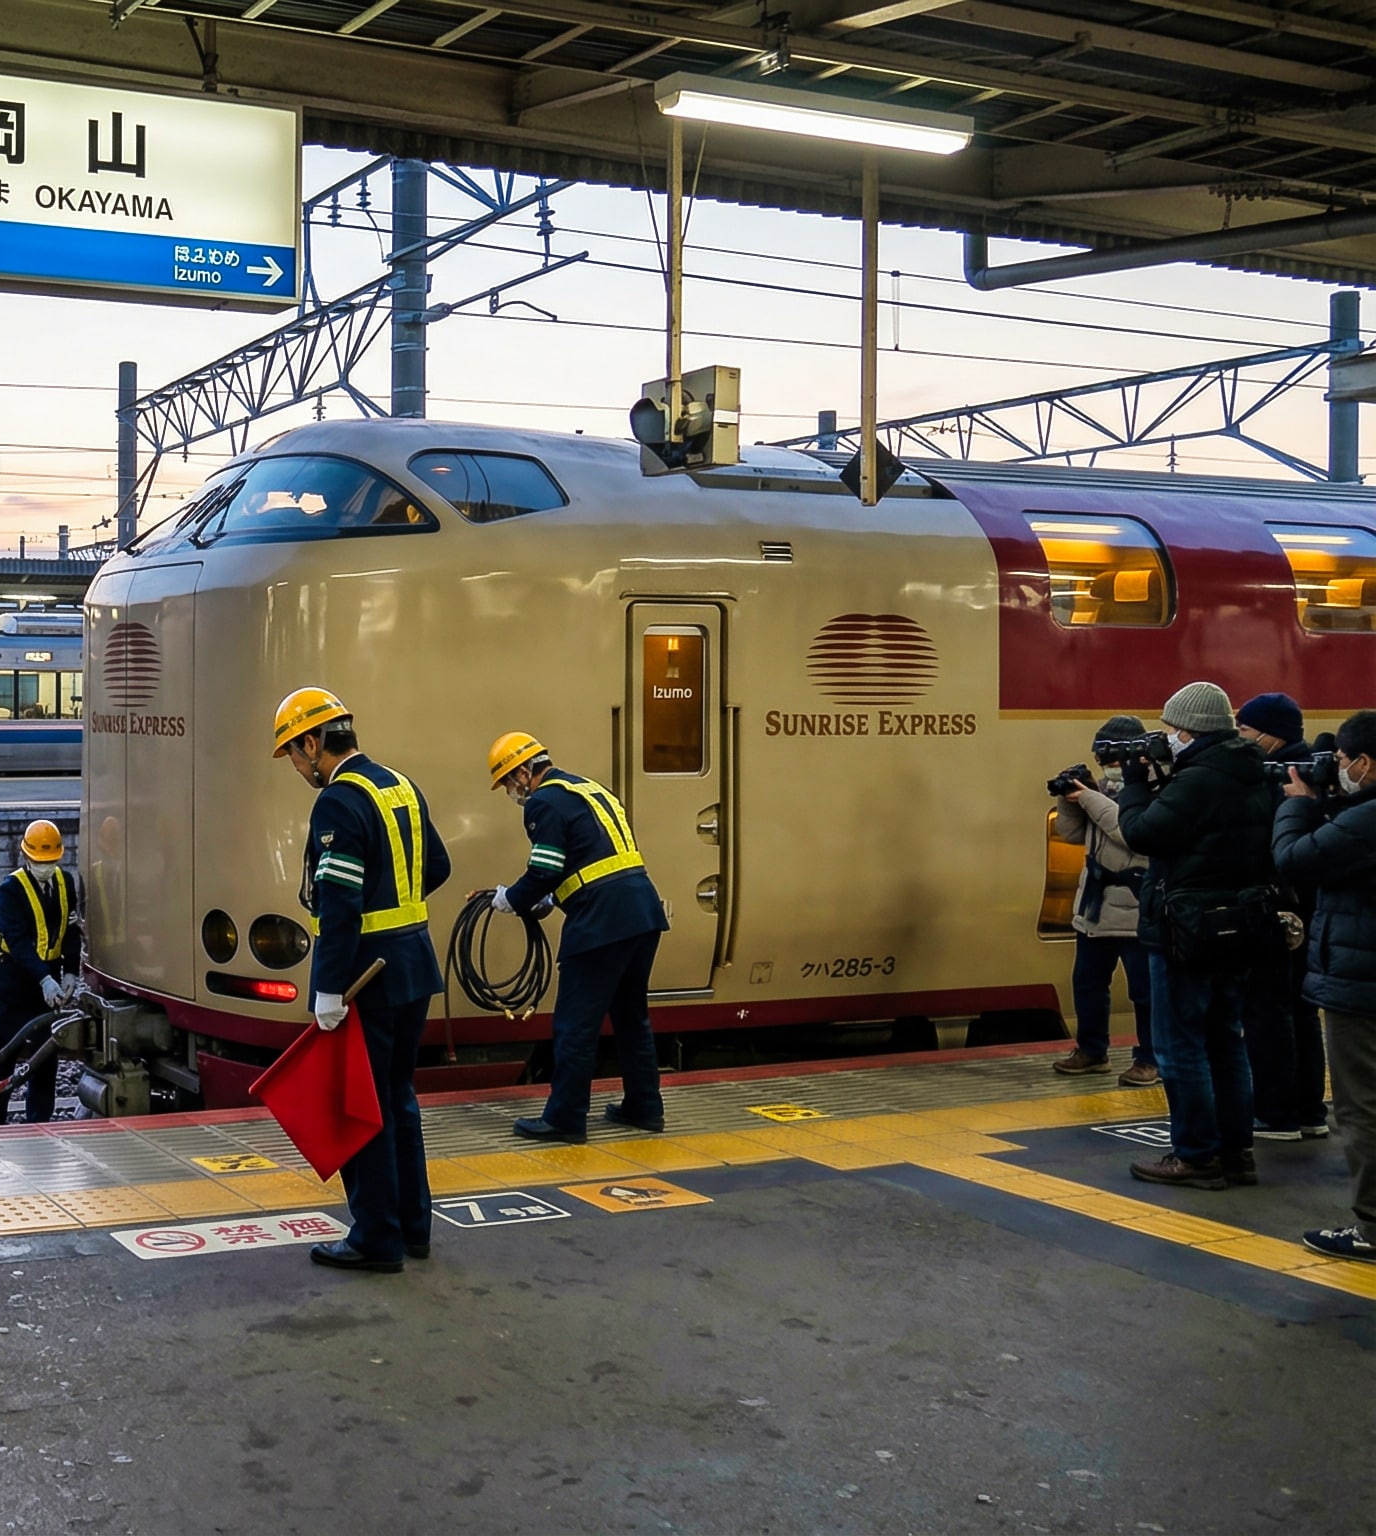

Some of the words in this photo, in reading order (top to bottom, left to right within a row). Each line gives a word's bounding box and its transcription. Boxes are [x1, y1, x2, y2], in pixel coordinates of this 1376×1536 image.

[35, 184, 174, 220] OKAYAMA
[174, 264, 222, 284] Izumo
[652, 684, 694, 700] Izumo
[129, 711, 186, 737] EXPRESS
[765, 710, 869, 737] SUNRISE
[877, 710, 977, 736] EXPRESS
[800, 955, 897, 979] クハ285-3
